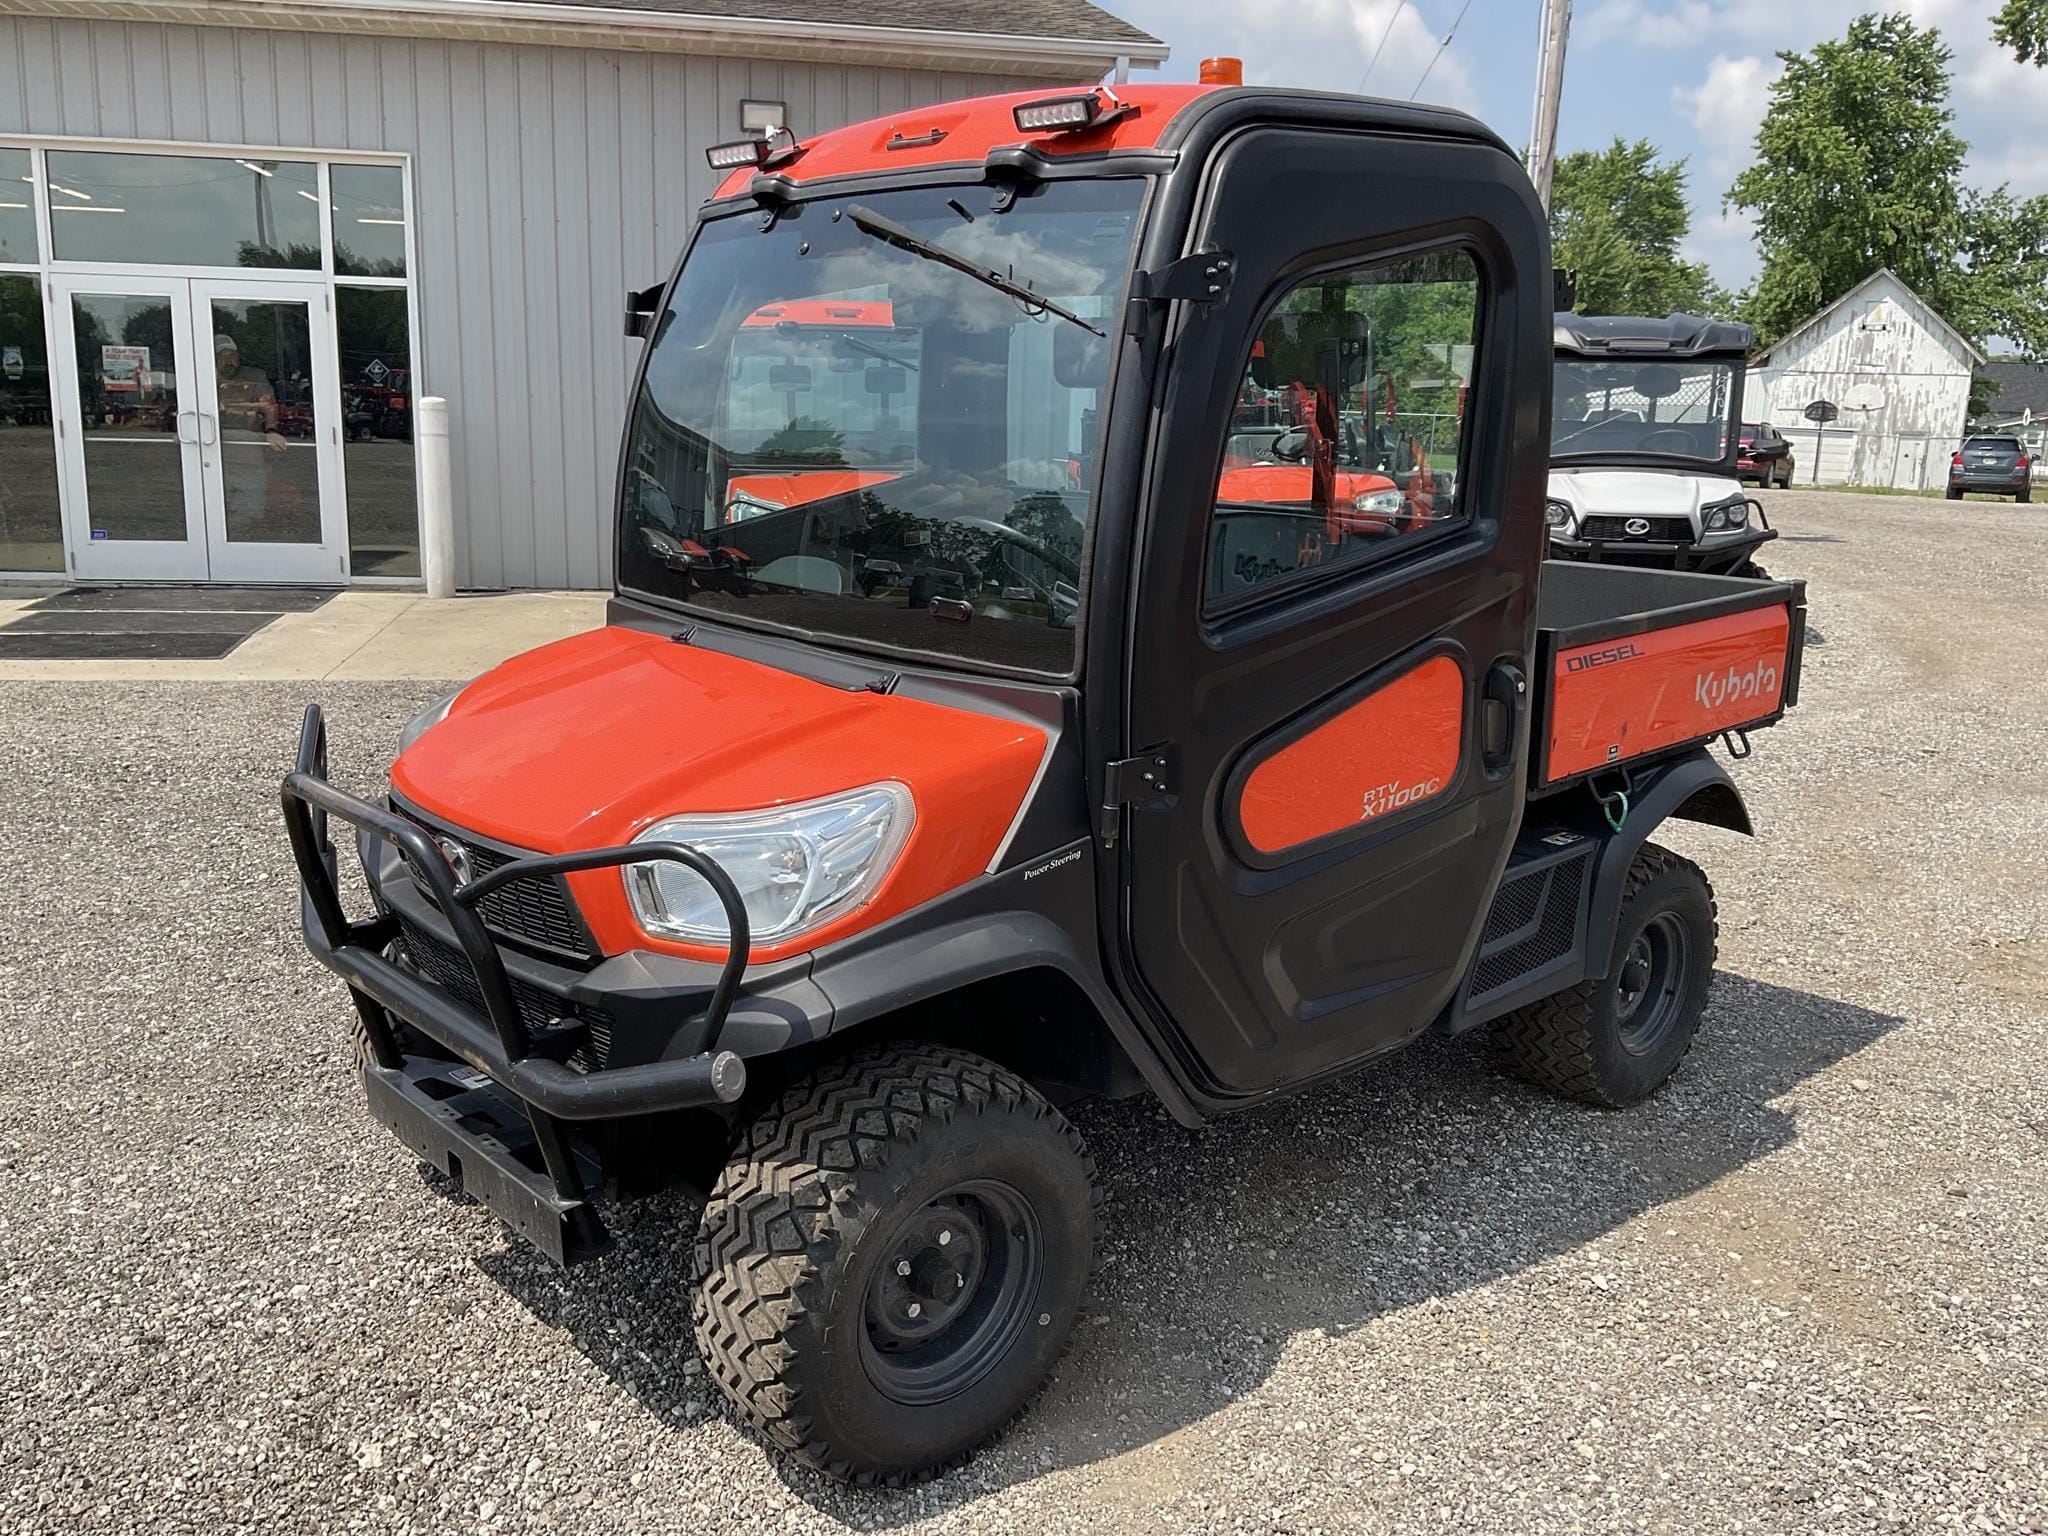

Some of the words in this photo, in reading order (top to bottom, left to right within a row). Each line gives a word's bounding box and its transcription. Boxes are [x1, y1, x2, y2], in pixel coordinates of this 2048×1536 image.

[1566, 644, 1645, 673] DIESEL
[1695, 659, 1776, 709] Kubota
[1360, 776, 1440, 820] X1100C
[1363, 780, 1400, 803] RTV
[1024, 864, 1050, 880] Power
[1049, 850, 1081, 869] Steering
